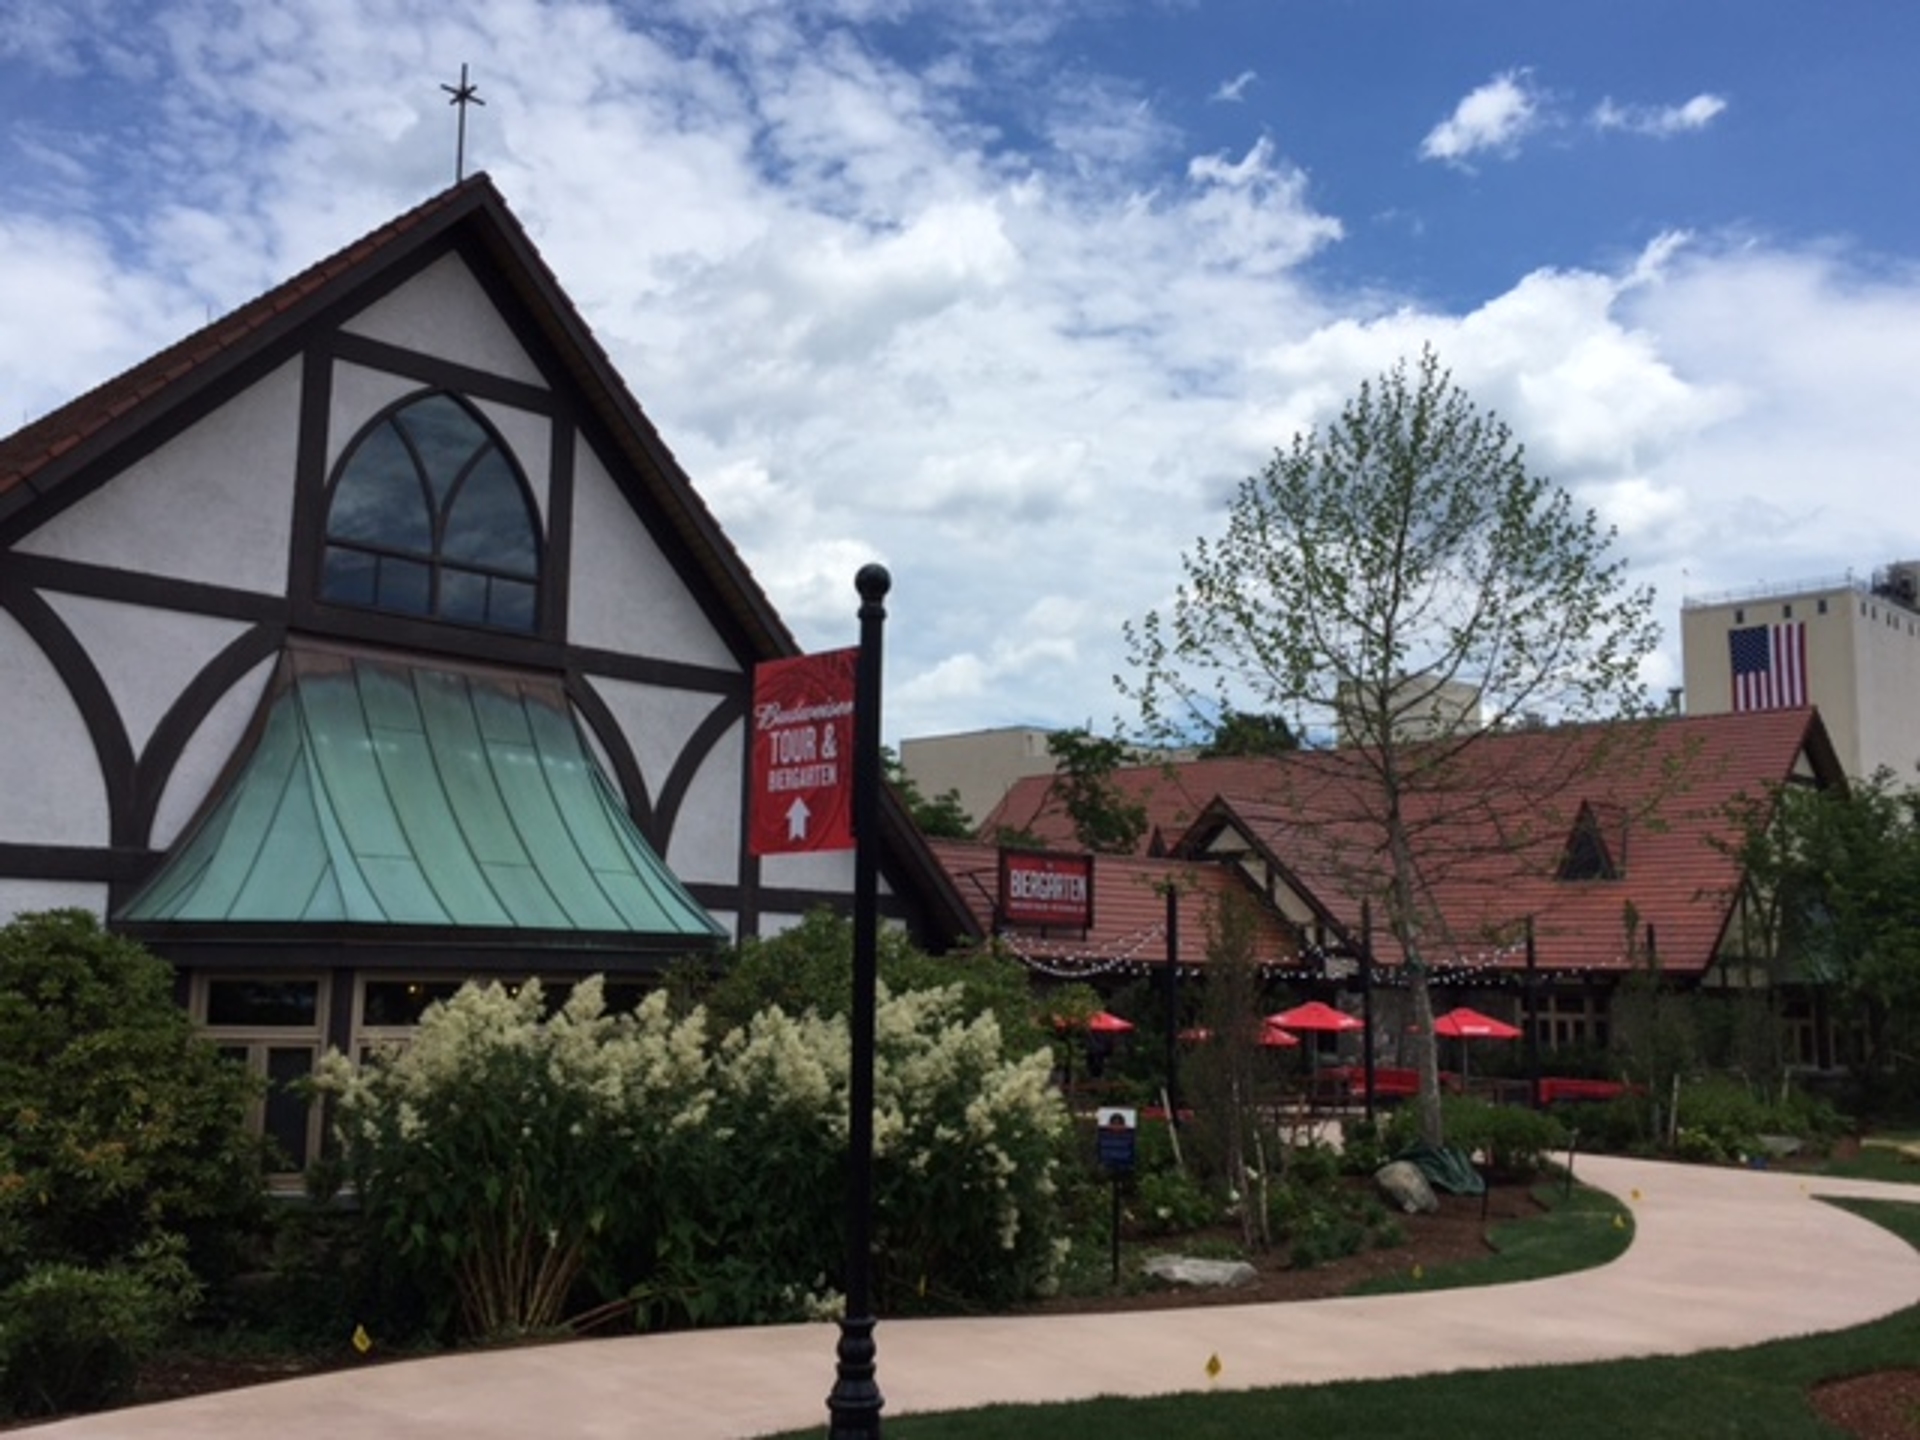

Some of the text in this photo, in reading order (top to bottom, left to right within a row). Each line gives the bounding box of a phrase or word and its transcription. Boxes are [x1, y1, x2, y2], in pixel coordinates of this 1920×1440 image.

[770, 723, 837, 765] TOUR &
[767, 763, 837, 792] BIERGARTEN
[1010, 869, 1087, 902] BIERGARTEN
